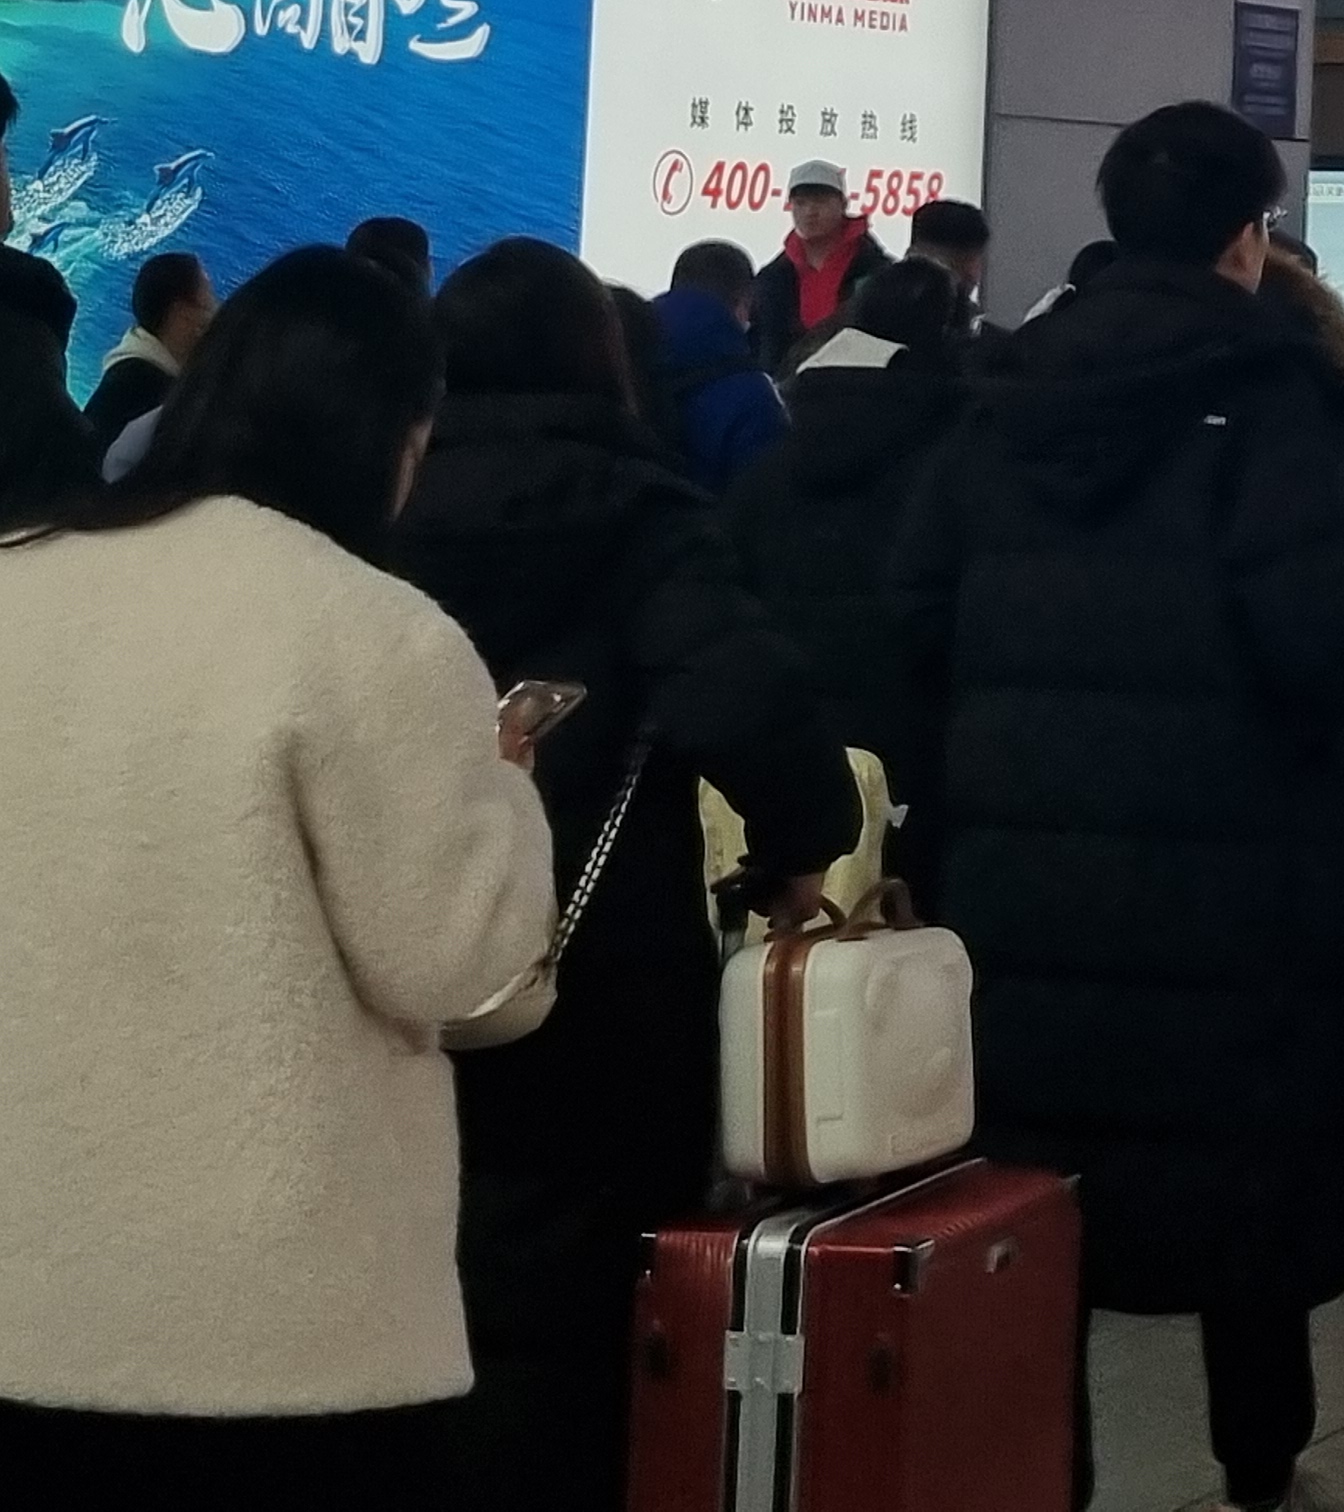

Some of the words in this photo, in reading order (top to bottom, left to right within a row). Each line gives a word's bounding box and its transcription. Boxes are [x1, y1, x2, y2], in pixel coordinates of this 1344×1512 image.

[788, 0, 846, 27] YINMA
[853, 7, 910, 33] MEDIA
[689, 96, 919, 144] 媒体投放热线
